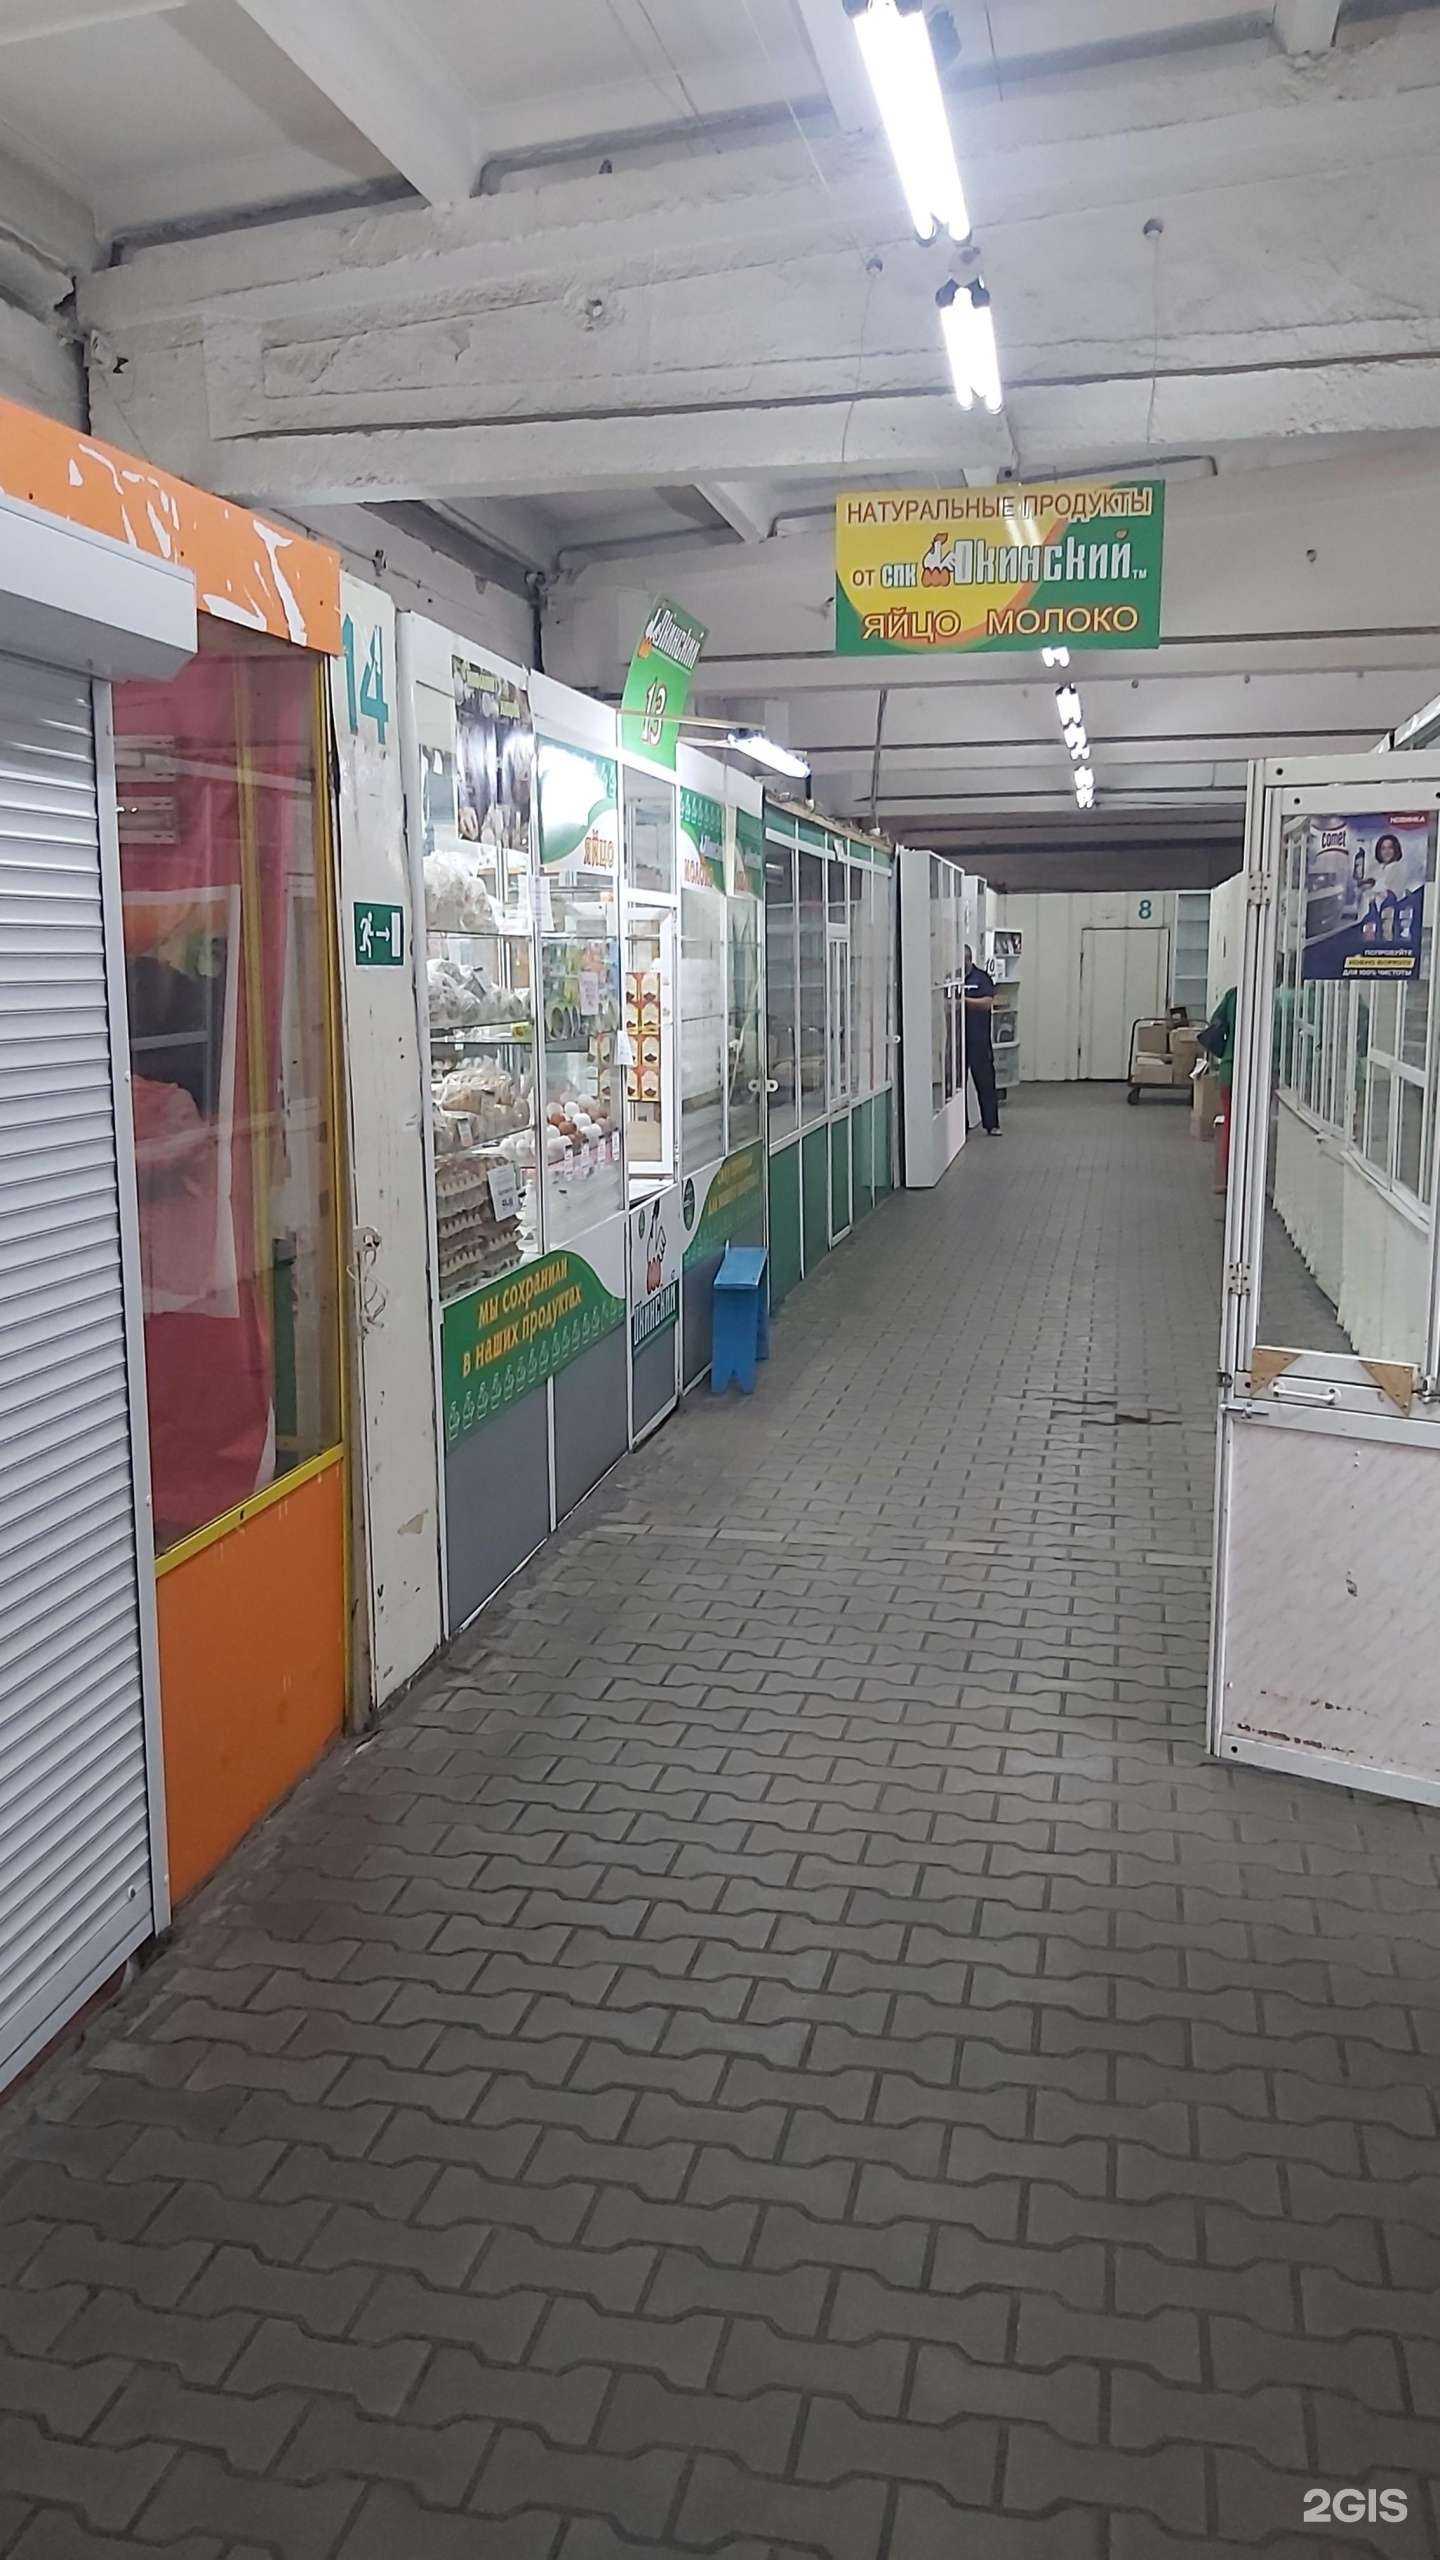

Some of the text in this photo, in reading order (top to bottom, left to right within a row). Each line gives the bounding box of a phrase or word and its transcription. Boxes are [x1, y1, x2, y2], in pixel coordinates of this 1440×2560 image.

[847, 488, 1151, 524] НАТУРАЛЬНЫЕ ПРОДУКТЫ
[862, 605, 1139, 643] ЯЙЦО МОЛОКО
[342, 613, 389, 745] 14
[640, 679, 668, 746] 13
[1138, 899, 1152, 920] 8
